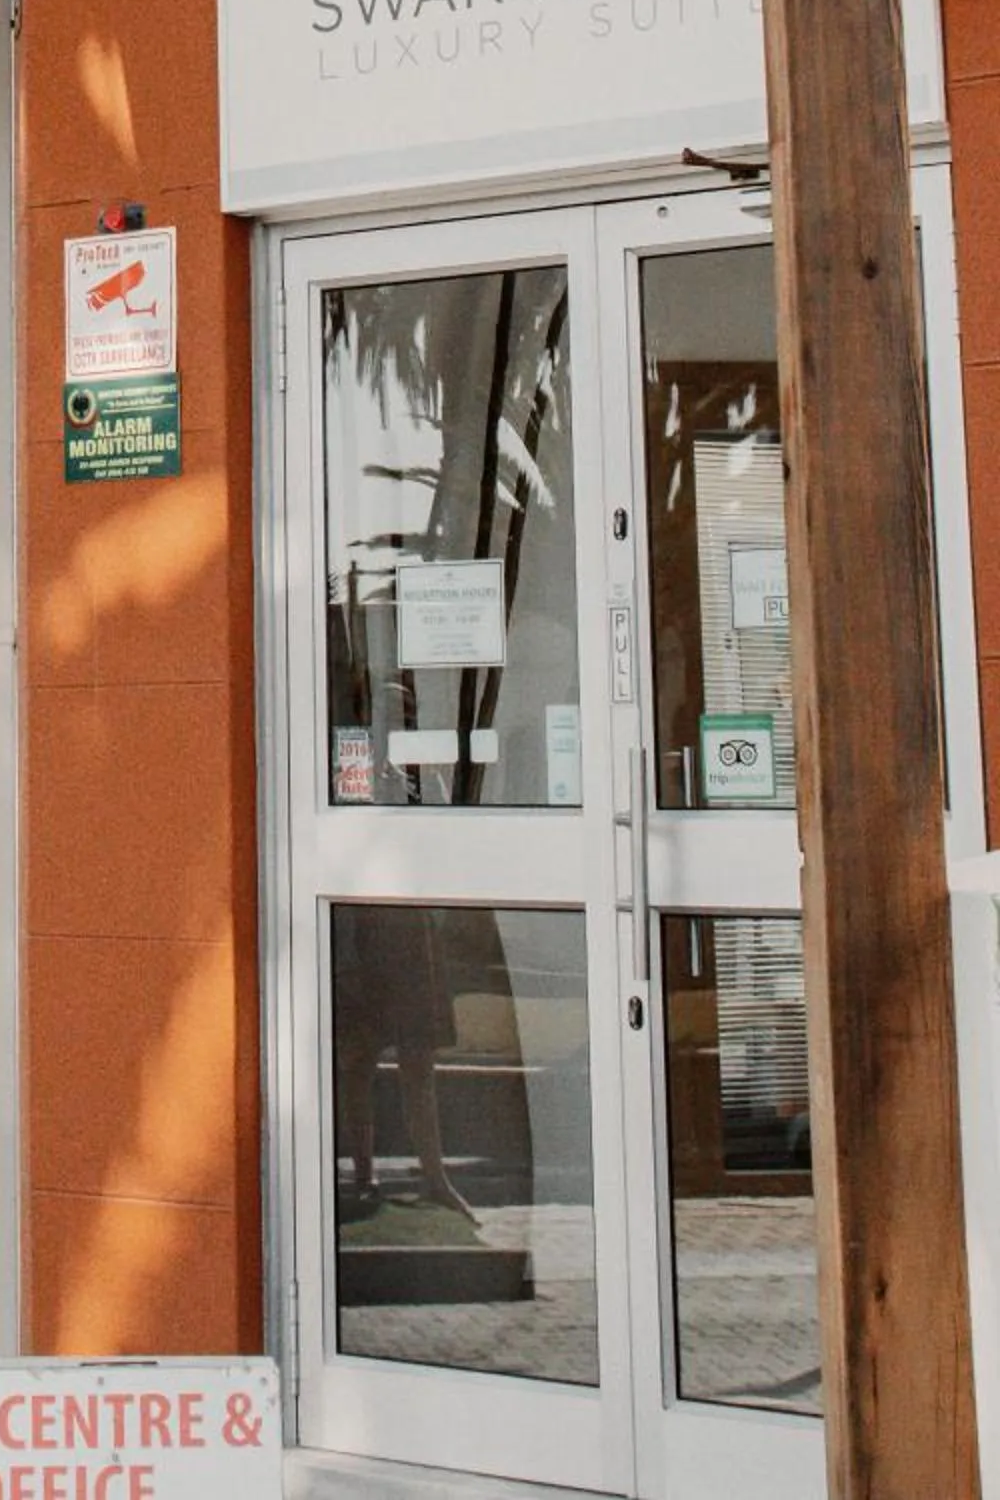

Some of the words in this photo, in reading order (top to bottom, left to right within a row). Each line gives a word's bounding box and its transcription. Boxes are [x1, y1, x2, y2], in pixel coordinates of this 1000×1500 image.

[318, 15, 545, 81] LUXURY
[69, 432, 177, 459] MONITORING
[93, 416, 153, 439] ALARM
[615, 613, 629, 697] PULL
[222, 1392, 264, 1448] &
